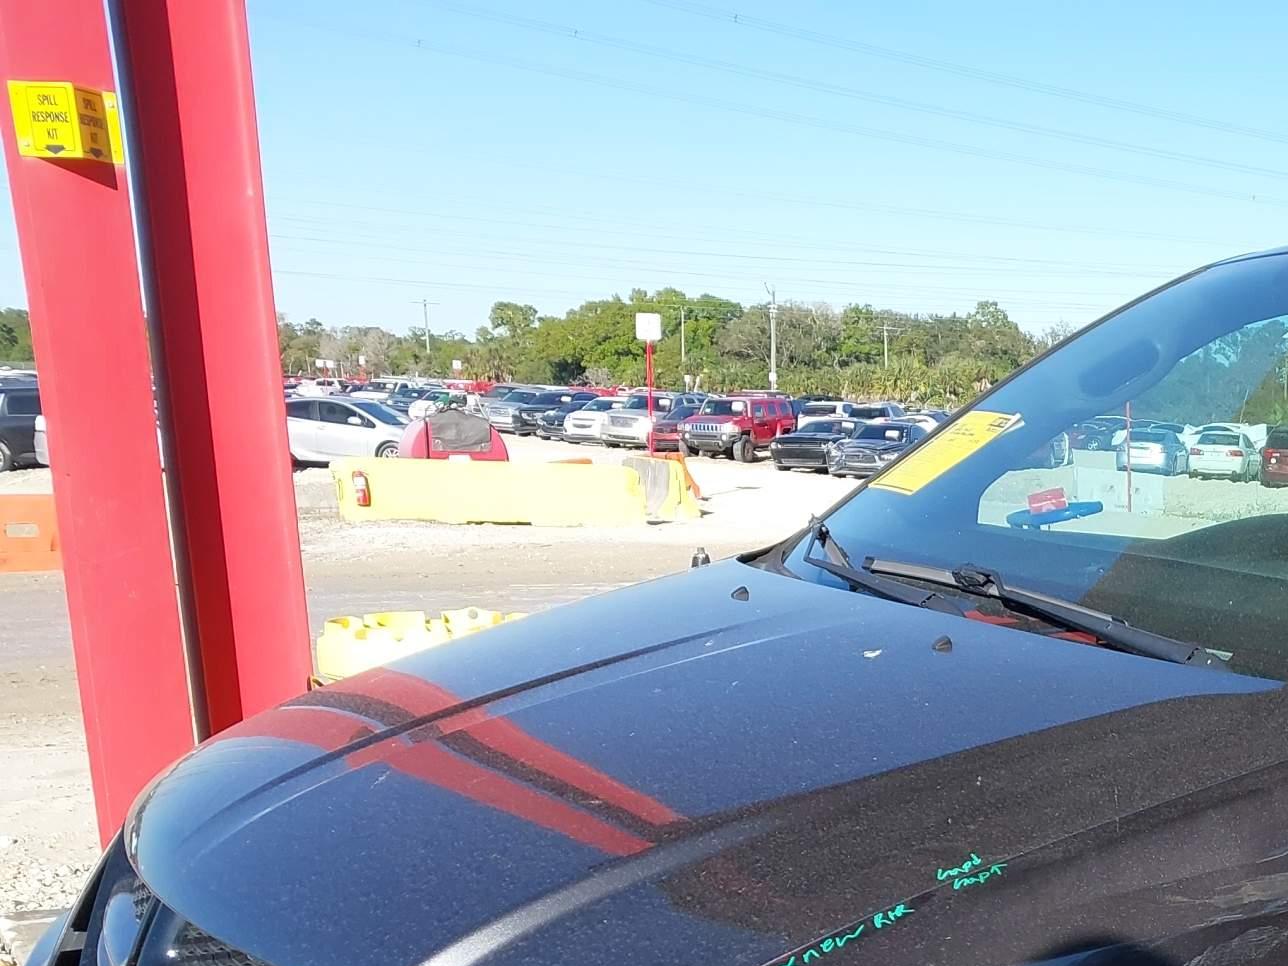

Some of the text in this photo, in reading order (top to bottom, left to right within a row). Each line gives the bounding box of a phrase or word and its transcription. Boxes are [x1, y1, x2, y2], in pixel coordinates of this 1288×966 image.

[36, 93, 59, 106] SPILL
[31, 110, 70, 123] RESPONSE
[47, 127, 59, 140] KIT
